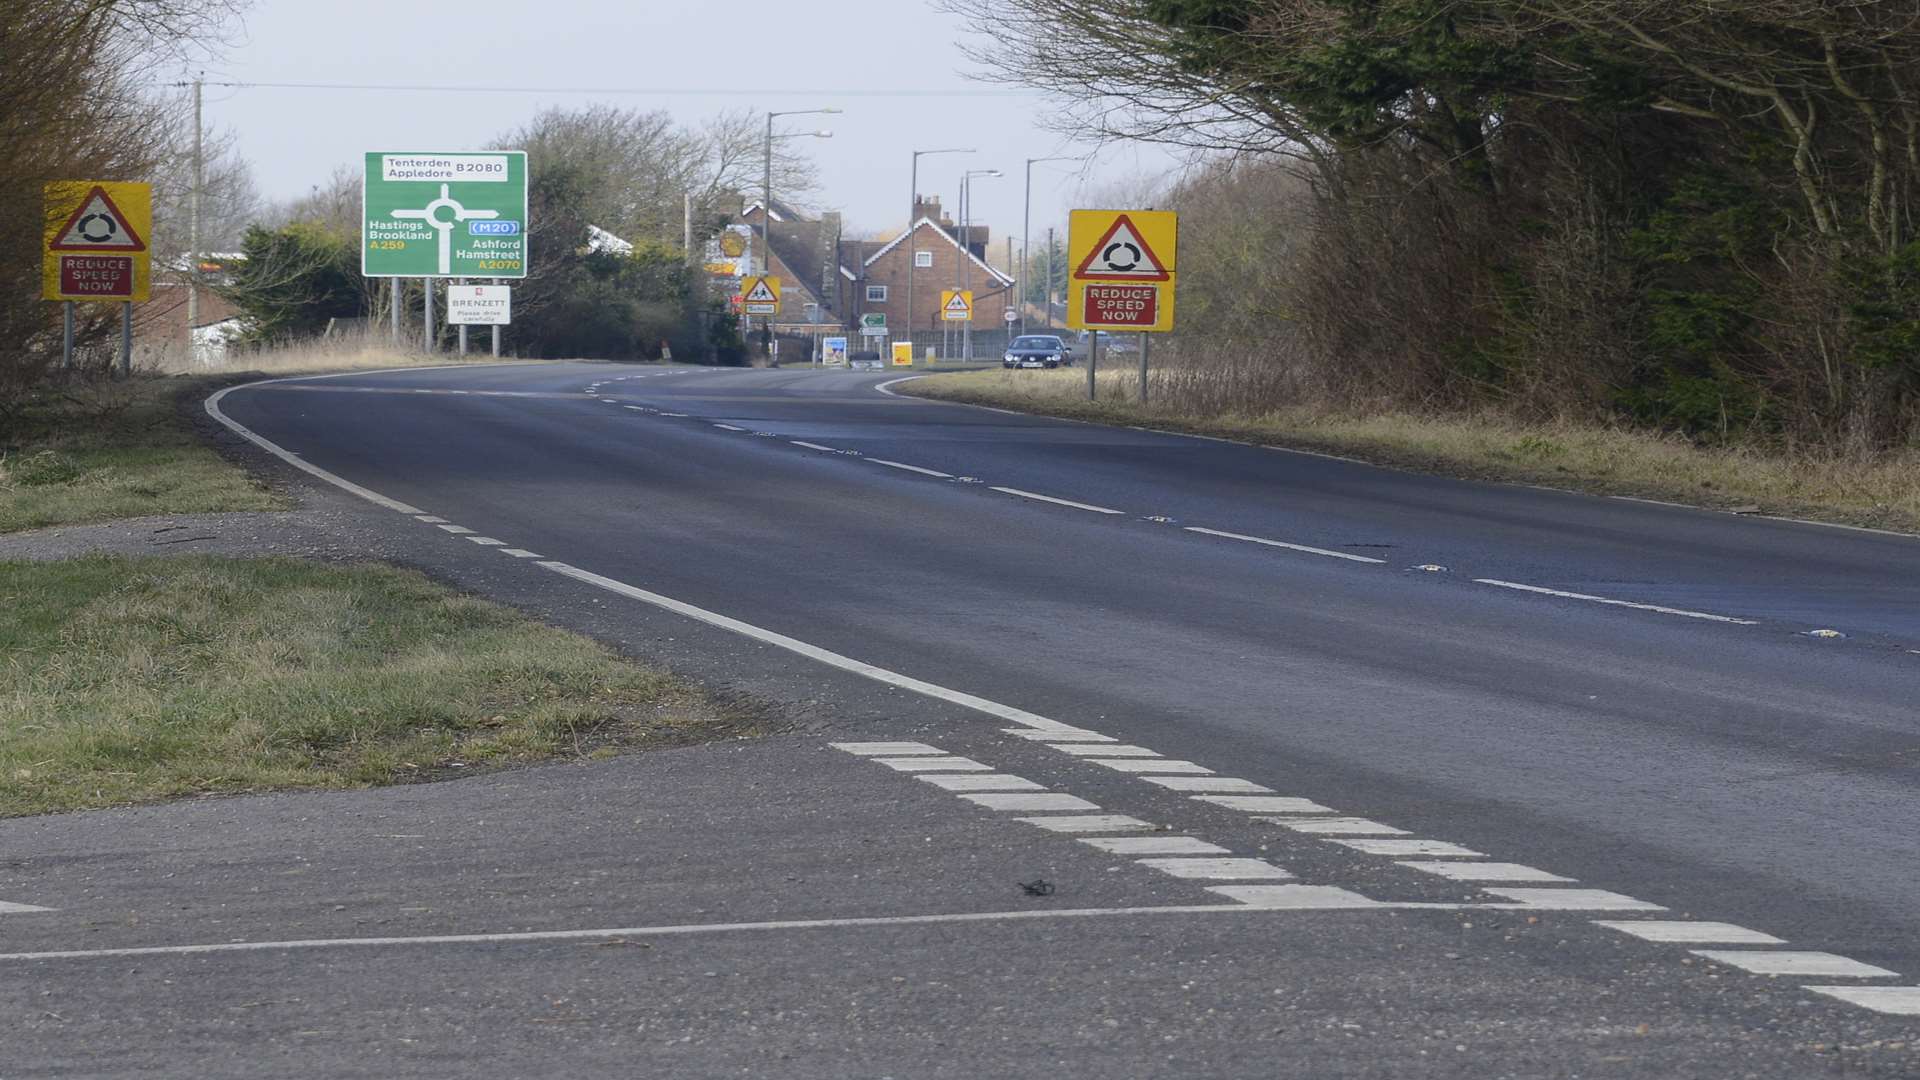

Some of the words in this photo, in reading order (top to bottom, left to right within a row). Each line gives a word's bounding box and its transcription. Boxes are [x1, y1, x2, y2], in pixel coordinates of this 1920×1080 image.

[388, 159, 451, 167] Tenterden
[456, 163, 503, 172] B2080
[388, 169, 453, 178] Appledore
[369, 221, 423, 231] Hastings
[472, 222, 516, 233] (M20)
[369, 231, 432, 240] Brookland
[472, 240, 520, 249] Ashford
[456, 250, 520, 259] Hamstreet
[79, 281, 114, 290] NOW
[1090, 289, 1152, 299] REDUCE
[1097, 300, 1145, 310] SPEED
[1102, 311, 1138, 320] NOW
